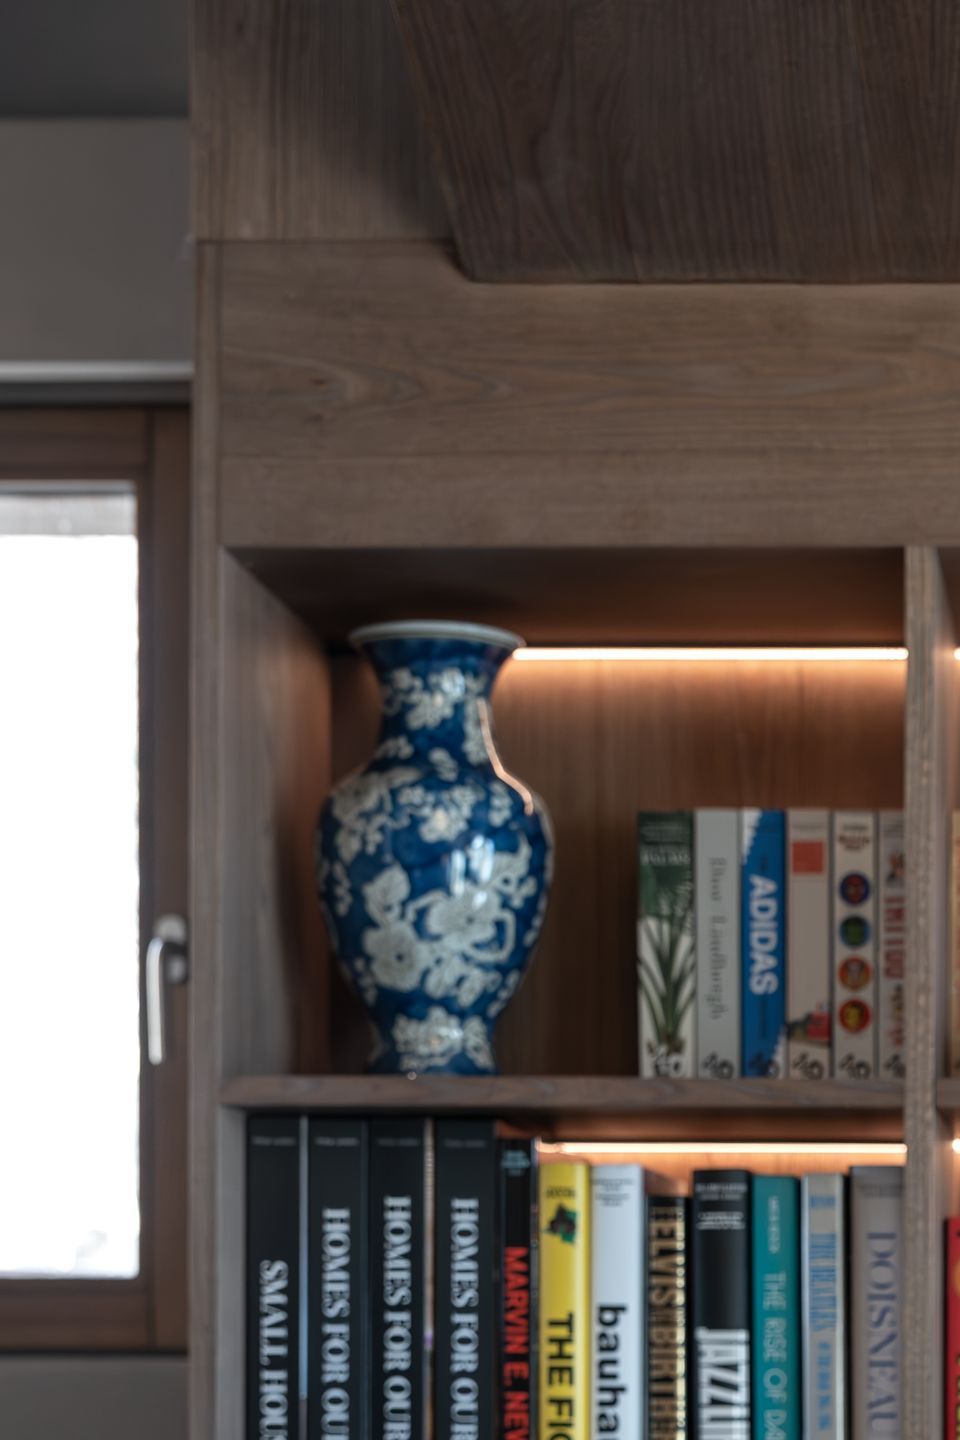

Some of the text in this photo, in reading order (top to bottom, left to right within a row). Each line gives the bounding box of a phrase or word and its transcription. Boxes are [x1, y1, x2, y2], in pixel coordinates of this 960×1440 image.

[749, 874, 779, 996] ADIDAS
[321, 1208, 351, 1319] HOMES
[383, 1196, 412, 1306] HOMES
[450, 1198, 479, 1308] HOMES
[648, 1220, 686, 1305] ELVIS
[763, 1272, 788, 1309] THE
[259, 1259, 288, 1366] SMALL
[383, 1310, 412, 1372] FOR
[450, 1312, 479, 1373] FOR
[504, 1247, 529, 1354] MARVIN
[763, 1318, 788, 1361] RISE
[867, 1232, 898, 1432] DOISNEAU
[321, 1323, 351, 1384] FOR
[504, 1359, 529, 1387] E.
[547, 1312, 576, 1385] THE
[648, 1329, 686, 1419] BIRTH
[763, 1367, 788, 1402] OF
